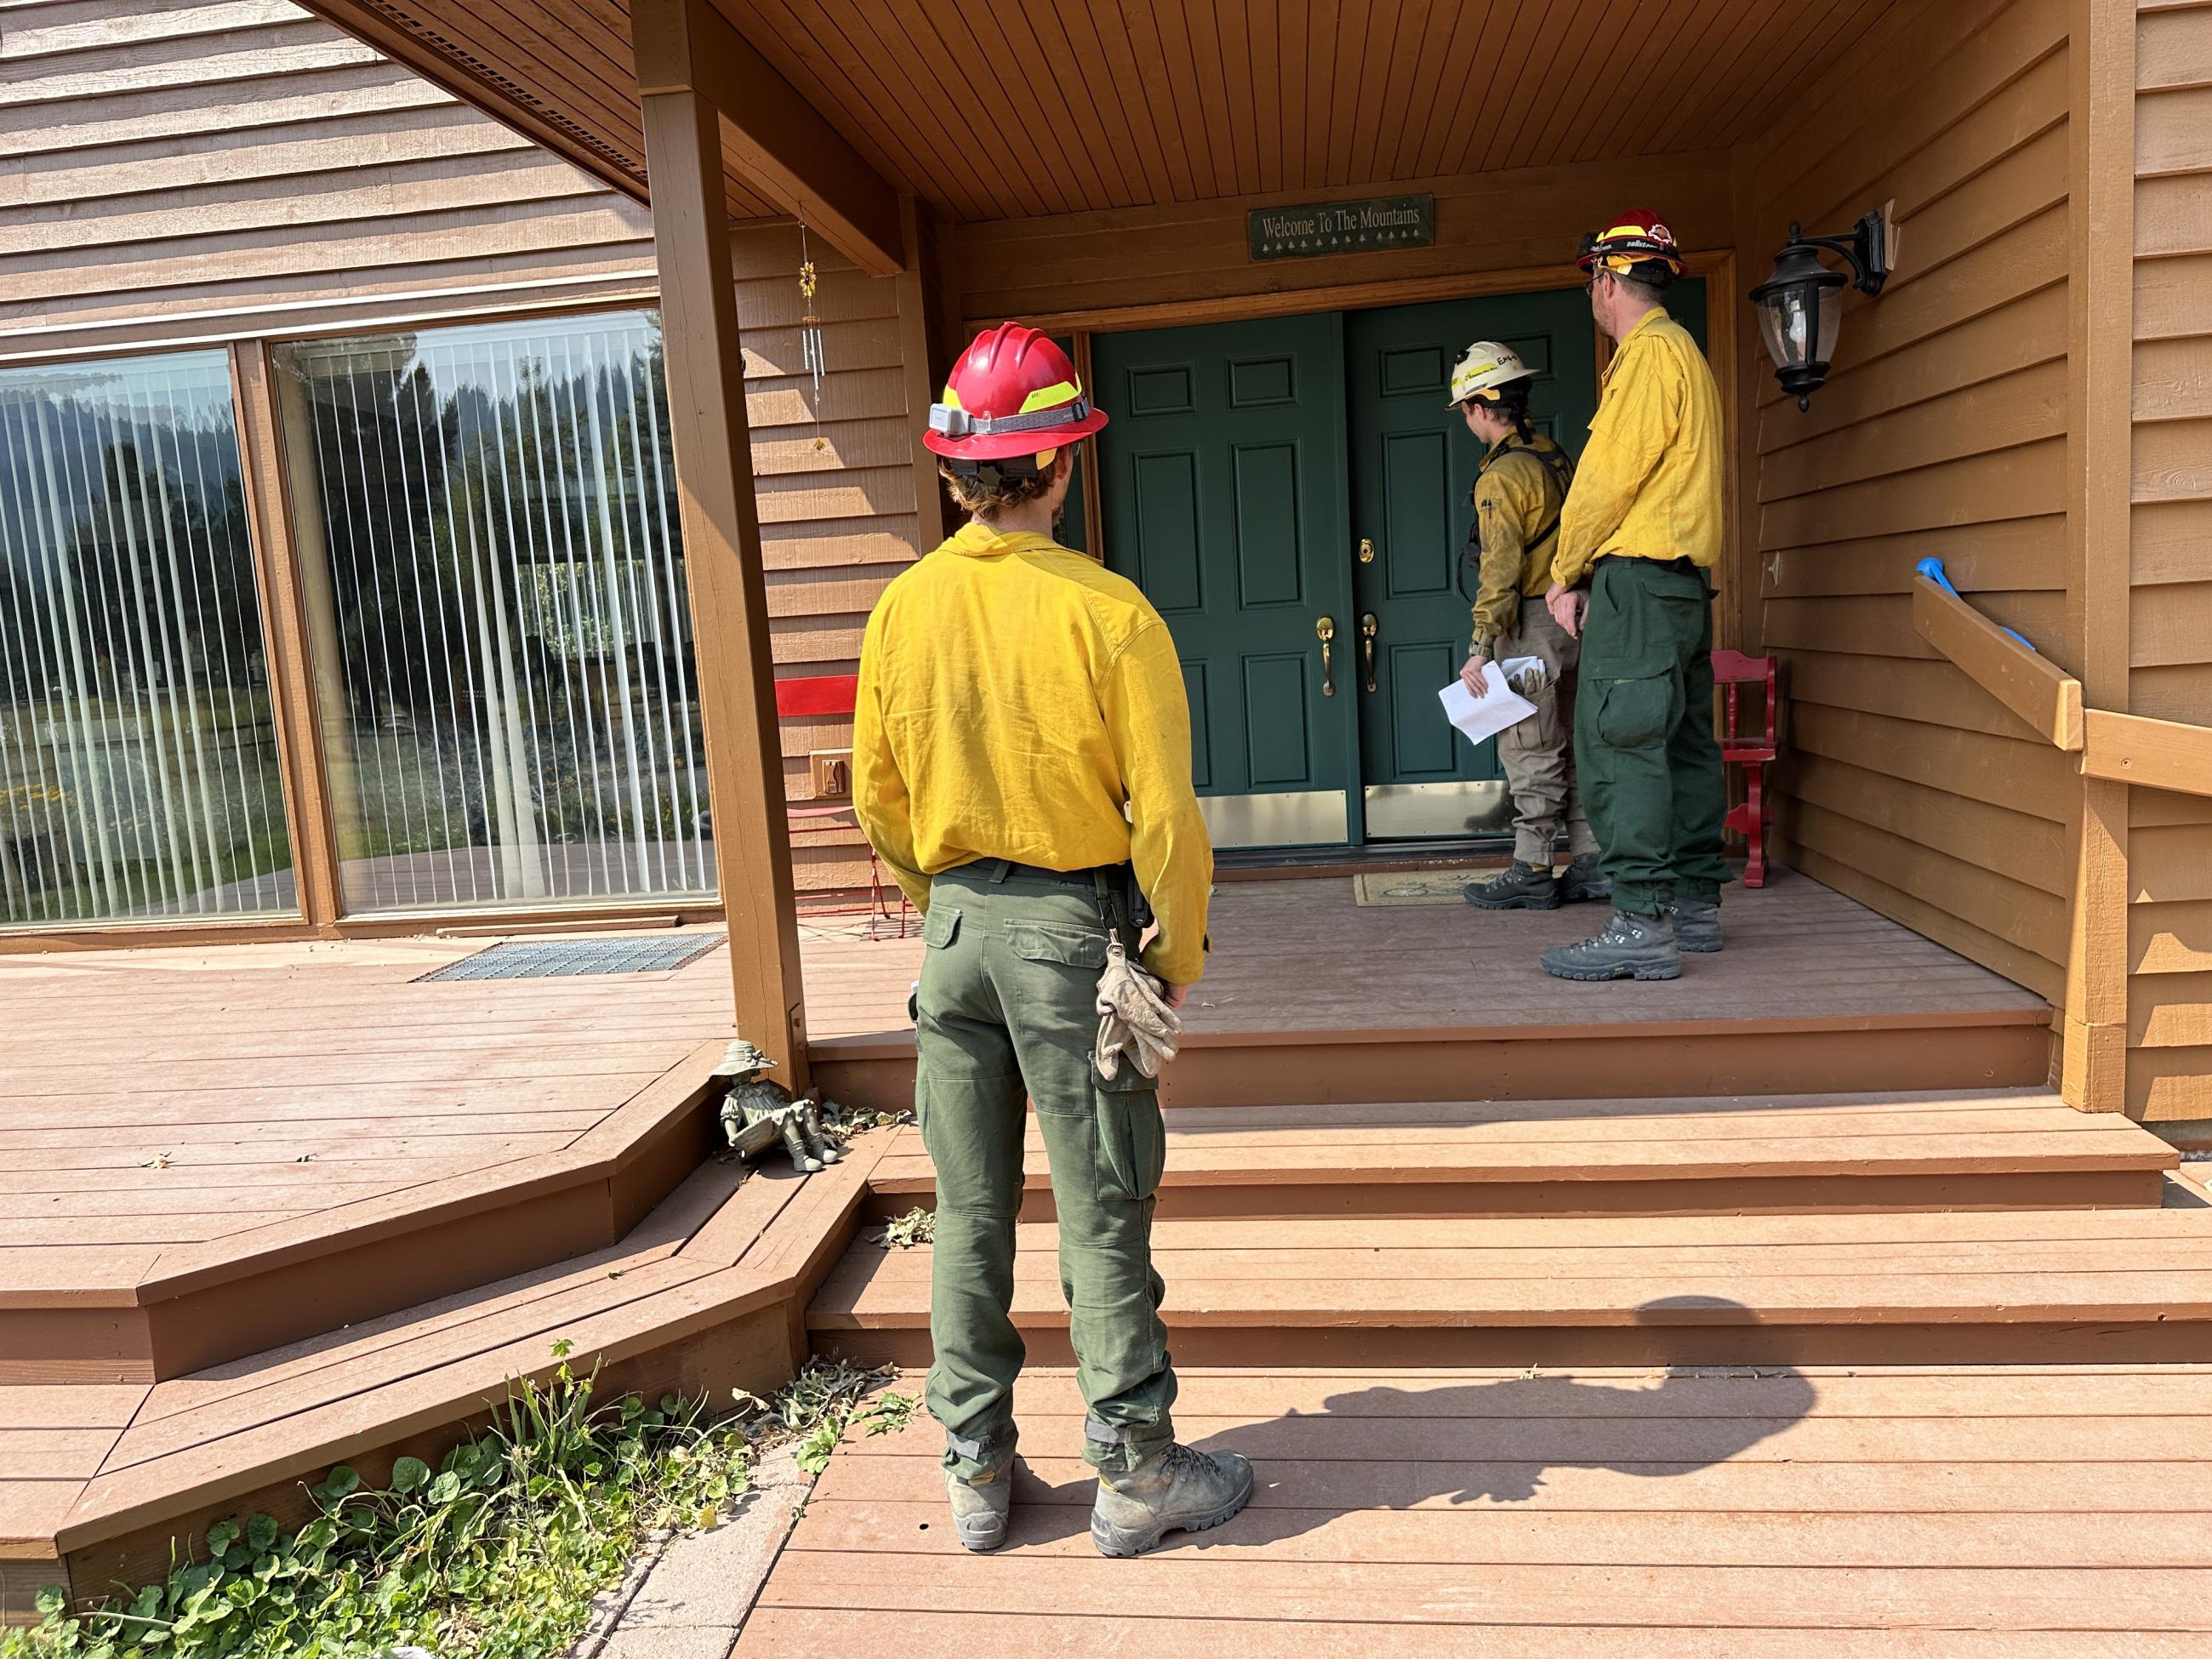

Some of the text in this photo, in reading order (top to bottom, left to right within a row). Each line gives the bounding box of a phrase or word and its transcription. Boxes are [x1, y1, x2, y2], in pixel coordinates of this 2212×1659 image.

[1263, 207, 1420, 239] Welcome To The Mountains
